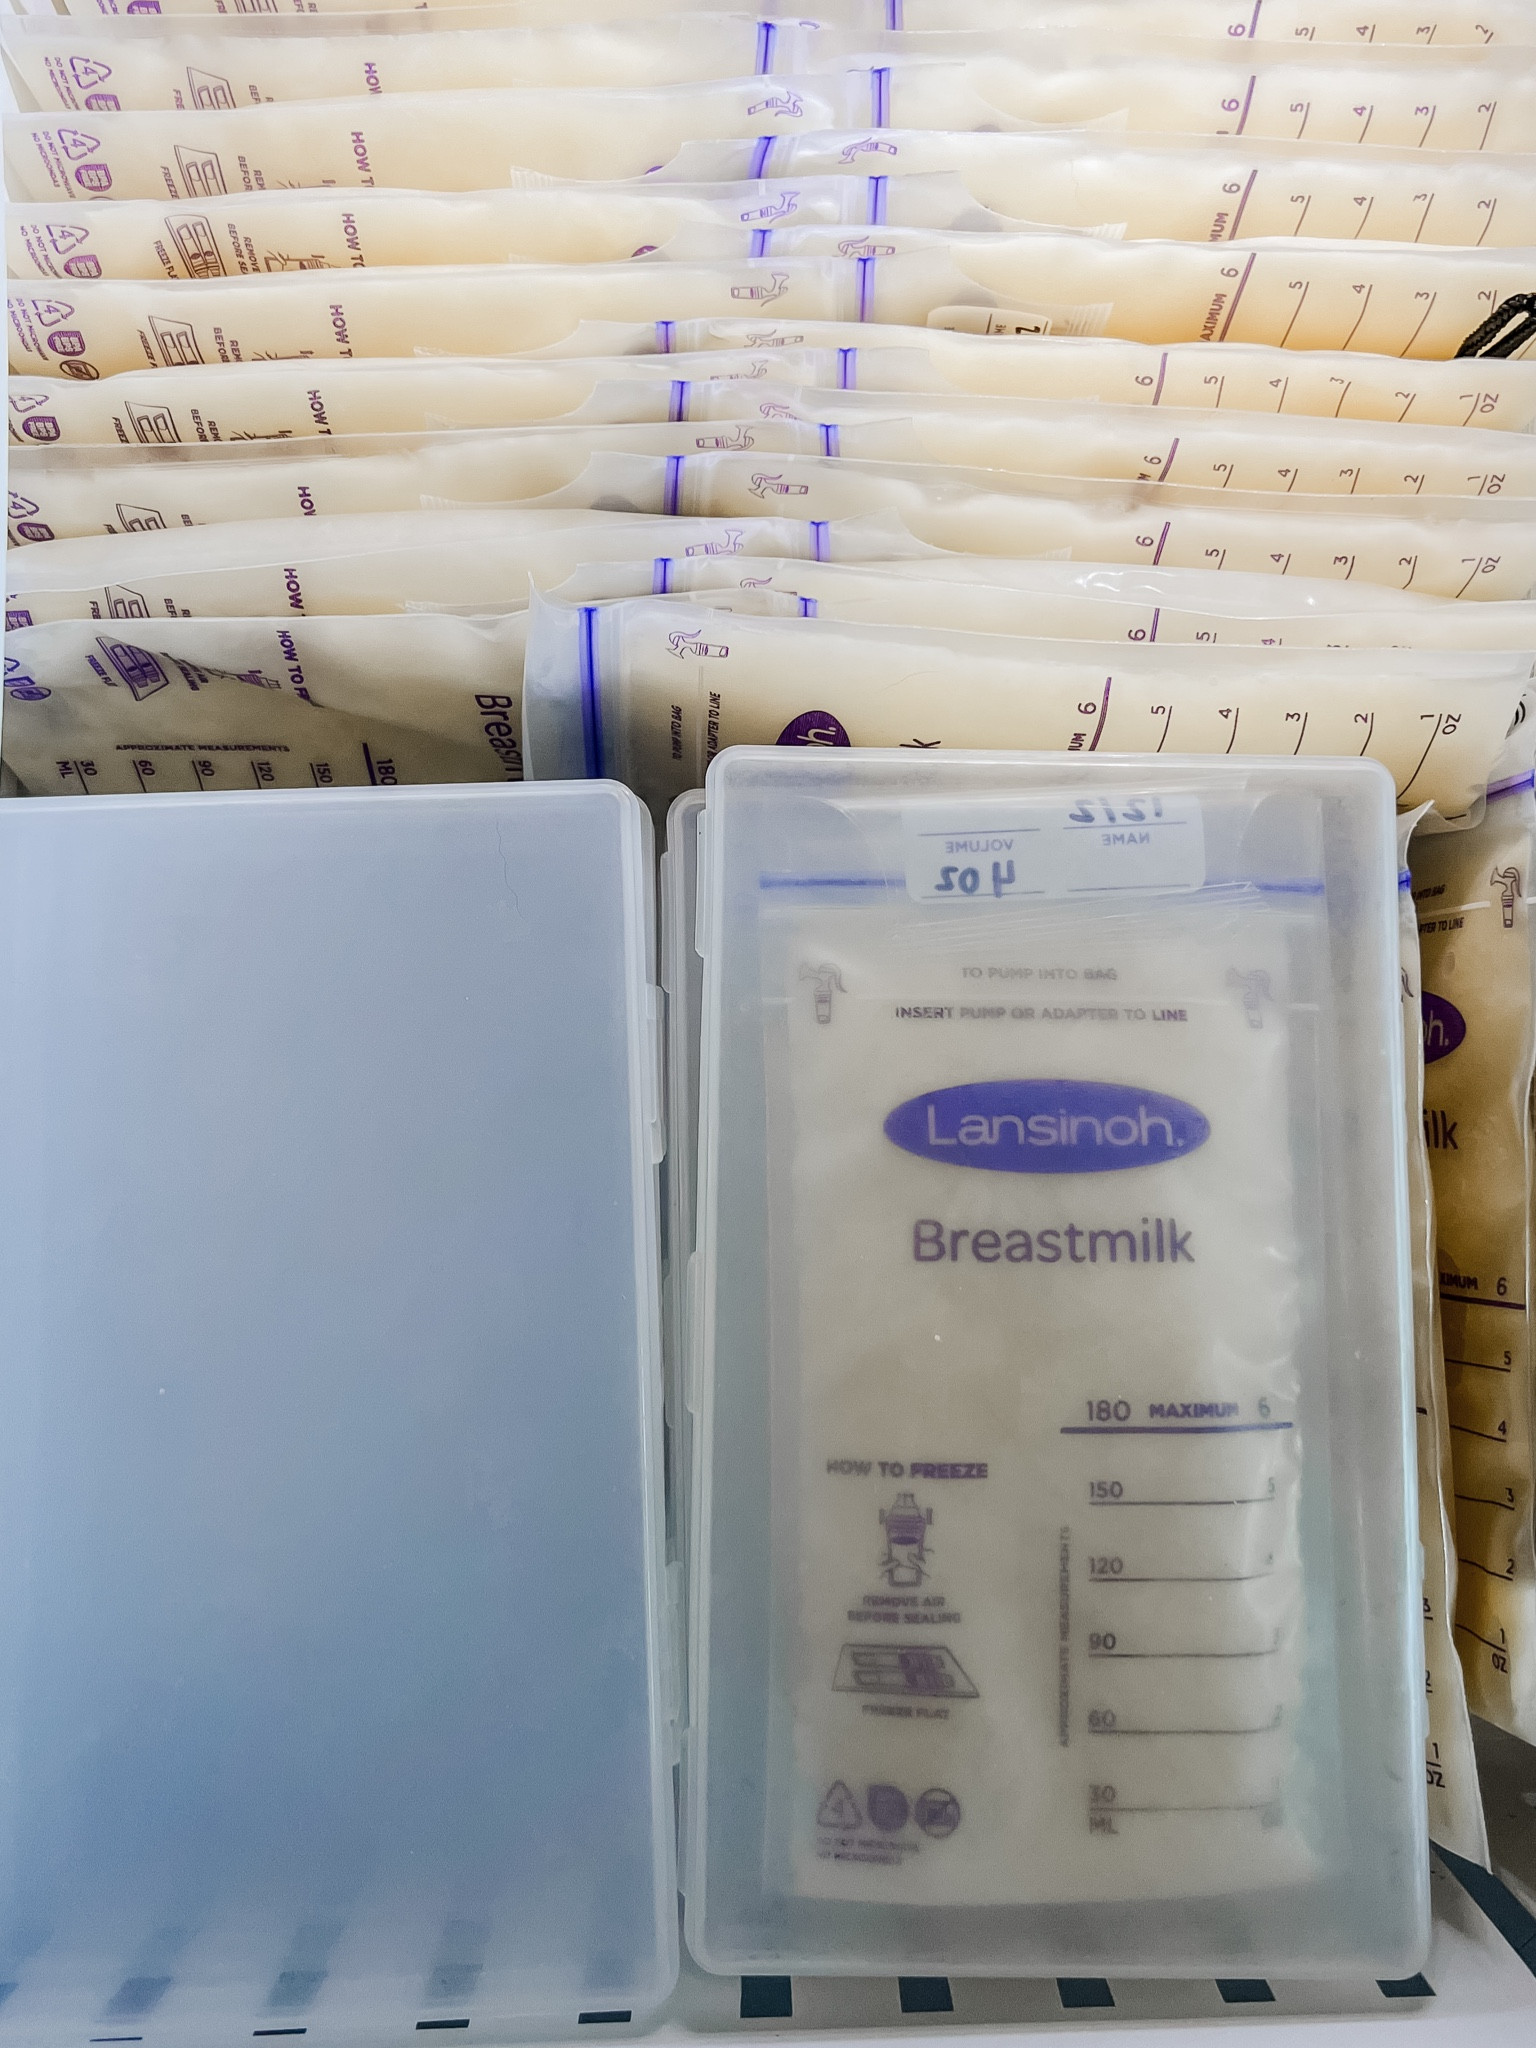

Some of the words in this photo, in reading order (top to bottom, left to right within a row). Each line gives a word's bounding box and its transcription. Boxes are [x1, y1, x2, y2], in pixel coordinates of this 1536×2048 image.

[1228, 23, 1246, 37] 6
[1296, 27, 1309, 37] 5
[1356, 26, 1369, 35] 4
[1416, 25, 1431, 34] 3
[1475, 24, 1489, 35] 2
[1221, 98, 1239, 112] 6
[1290, 102, 1304, 113] 5
[1354, 106, 1367, 117] 4
[1415, 105, 1429, 116] 3
[1478, 103, 1492, 113] 2
[351, 131, 372, 173] HOW
[238, 155, 253, 191] BEFOR
[1222, 183, 1240, 194] 6
[1291, 195, 1305, 204] 5
[1354, 196, 1367, 206] 4
[1413, 193, 1428, 202] 3
[1478, 200, 1492, 210] 2
[342, 213, 361, 251] HOW
[228, 223, 244, 260] BEFORE
[243, 236, 261, 273] REMOVE
[1289, 281, 1303, 289] 5
[1352, 284, 1366, 294] 4
[1415, 291, 1430, 300] 3
[1478, 290, 1492, 301] 2
[1200, 293, 1227, 341] AXIMUM
[1221, 267, 1239, 278] 6
[329, 304, 349, 344] HOW
[213, 327, 230, 363] BEFOR
[1136, 376, 1153, 387] 6
[1204, 376, 1218, 385] 5
[1269, 378, 1283, 388] 4
[1395, 391, 1410, 399] 2
[307, 390, 328, 425] HOW
[1480, 393, 1499, 413] OZ
[112, 416, 130, 443] FREEZ
[191, 409, 209, 442] BEFOR
[1144, 456, 1162, 465] 6
[1213, 464, 1227, 472] 5
[1278, 468, 1291, 478] 4
[1340, 468, 1354, 478] 3
[1404, 474, 1419, 484] 2
[1488, 473, 1506, 494] OZ
[1136, 535, 1154, 548] 6
[1205, 549, 1220, 559] 5
[1270, 553, 1284, 563] 4
[1333, 555, 1348, 566] 3
[1399, 557, 1413, 566] 2
[1481, 556, 1501, 573] OZ
[283, 568, 305, 609] HOW
[1128, 629, 1146, 641] 6
[276, 630, 299, 662] HOW
[288, 666, 304, 686] TO
[709, 691, 721, 710] LINE
[671, 704, 682, 721] BAG
[708, 709, 720, 720] TO
[1078, 702, 1096, 715] 6
[1151, 705, 1165, 715] 5
[1218, 708, 1232, 719] 4
[1285, 711, 1300, 721] 3
[1354, 714, 1368, 723] 2
[1442, 713, 1461, 734] OZ
[115, 744, 195, 752] APPROXIMATE
[56, 761, 74, 779] ML
[80, 760, 98, 776] 30
[138, 760, 155, 776] 60
[198, 760, 215, 776] 90
[256, 761, 275, 782] 120
[315, 762, 333, 784] 150
[961, 967, 982, 980] TO
[988, 967, 1034, 981] PUMP
[1038, 967, 1079, 981] INTO
[1083, 967, 1118, 981] BAG
[895, 1006, 954, 1021] INSERT
[959, 1006, 1007, 1021] PUMP
[1011, 1007, 1036, 1021] OR
[1041, 1007, 1119, 1022] ADAPTER
[1124, 1007, 1147, 1022] TO
[1152, 1008, 1188, 1023] LINE
[912, 1217, 1196, 1265] Breastmilk
[1496, 1277, 1507, 1296] 6
[1503, 1351, 1512, 1365] 5
[1086, 1401, 1131, 1423] 180
[1149, 1403, 1239, 1419] MAXIMUM
[1497, 1420, 1507, 1435] 4
[827, 1459, 871, 1476] HOW
[878, 1461, 906, 1477] TO
[910, 1462, 988, 1479] FREEZE
[1088, 1481, 1123, 1498] 150
[1089, 1557, 1123, 1574] 120
[1506, 1558, 1515, 1575] 2
[1089, 1633, 1116, 1651] 90
[1492, 1654, 1508, 1673] OZ
[1089, 1709, 1116, 1728] 60
